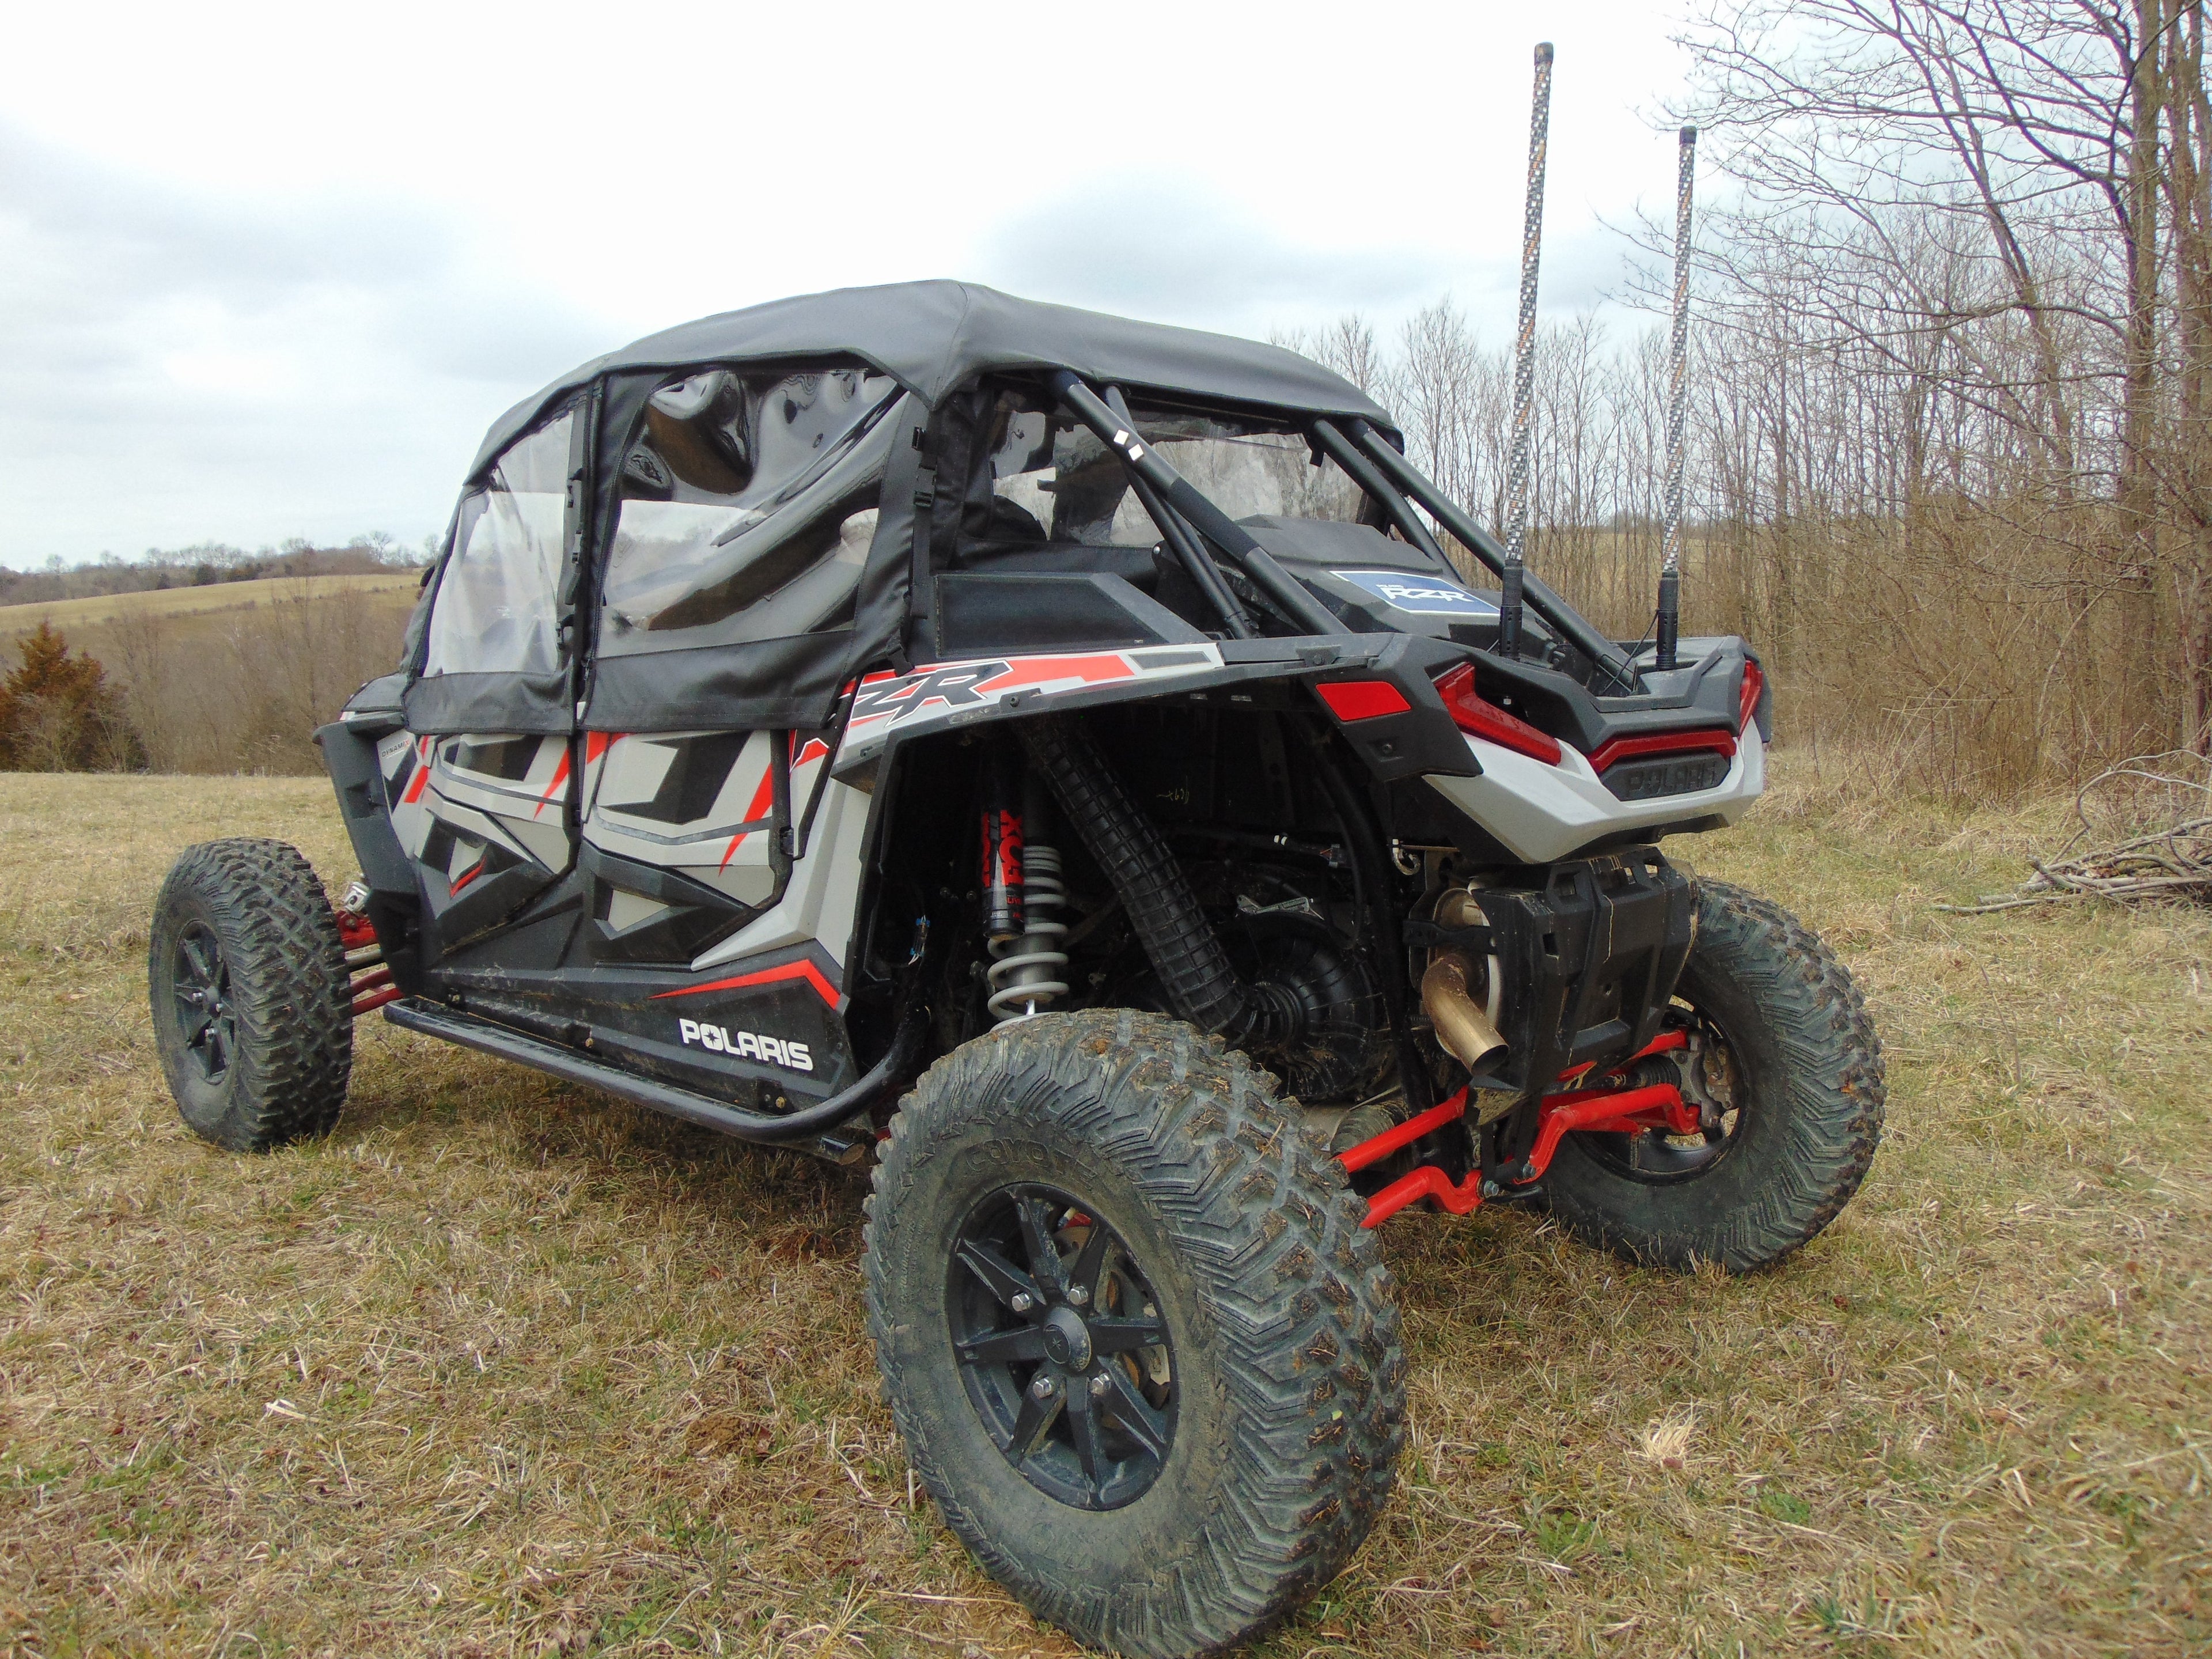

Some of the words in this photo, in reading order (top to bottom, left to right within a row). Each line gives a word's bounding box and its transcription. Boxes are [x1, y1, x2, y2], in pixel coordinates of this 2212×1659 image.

[1379, 588, 1474, 602] RZR
[381, 739, 410, 757] DYNAMIX
[679, 1018, 813, 1071] POLARIS
